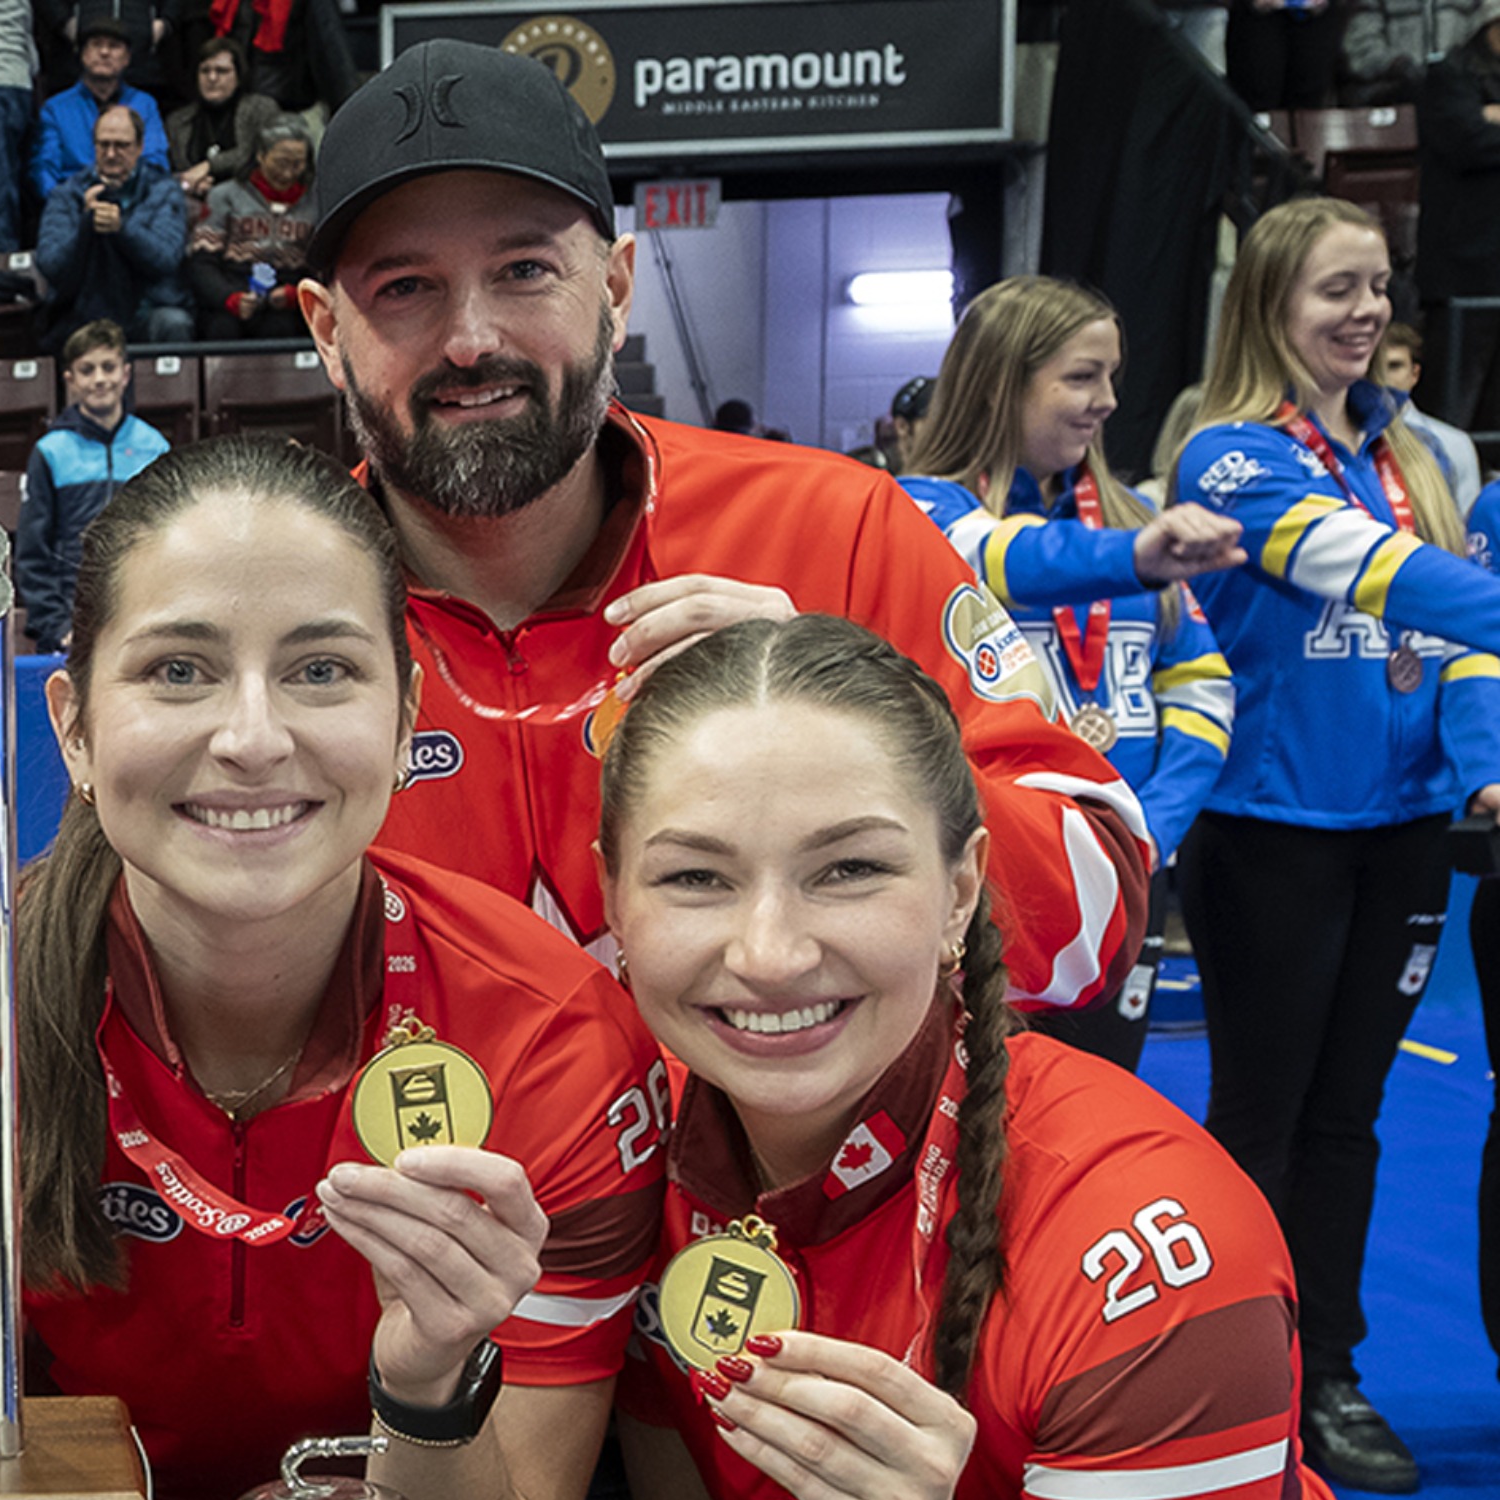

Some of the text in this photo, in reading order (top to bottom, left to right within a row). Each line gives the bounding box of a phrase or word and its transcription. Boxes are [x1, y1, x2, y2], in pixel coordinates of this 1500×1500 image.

[634, 43, 907, 108] paramount
[661, 93, 880, 115] MIDDLE EASTERN KITCHEN
[644, 184, 710, 229] EXIT
[154, 1161, 226, 1227] Scotties
[1081, 1197, 1214, 1325] 26
